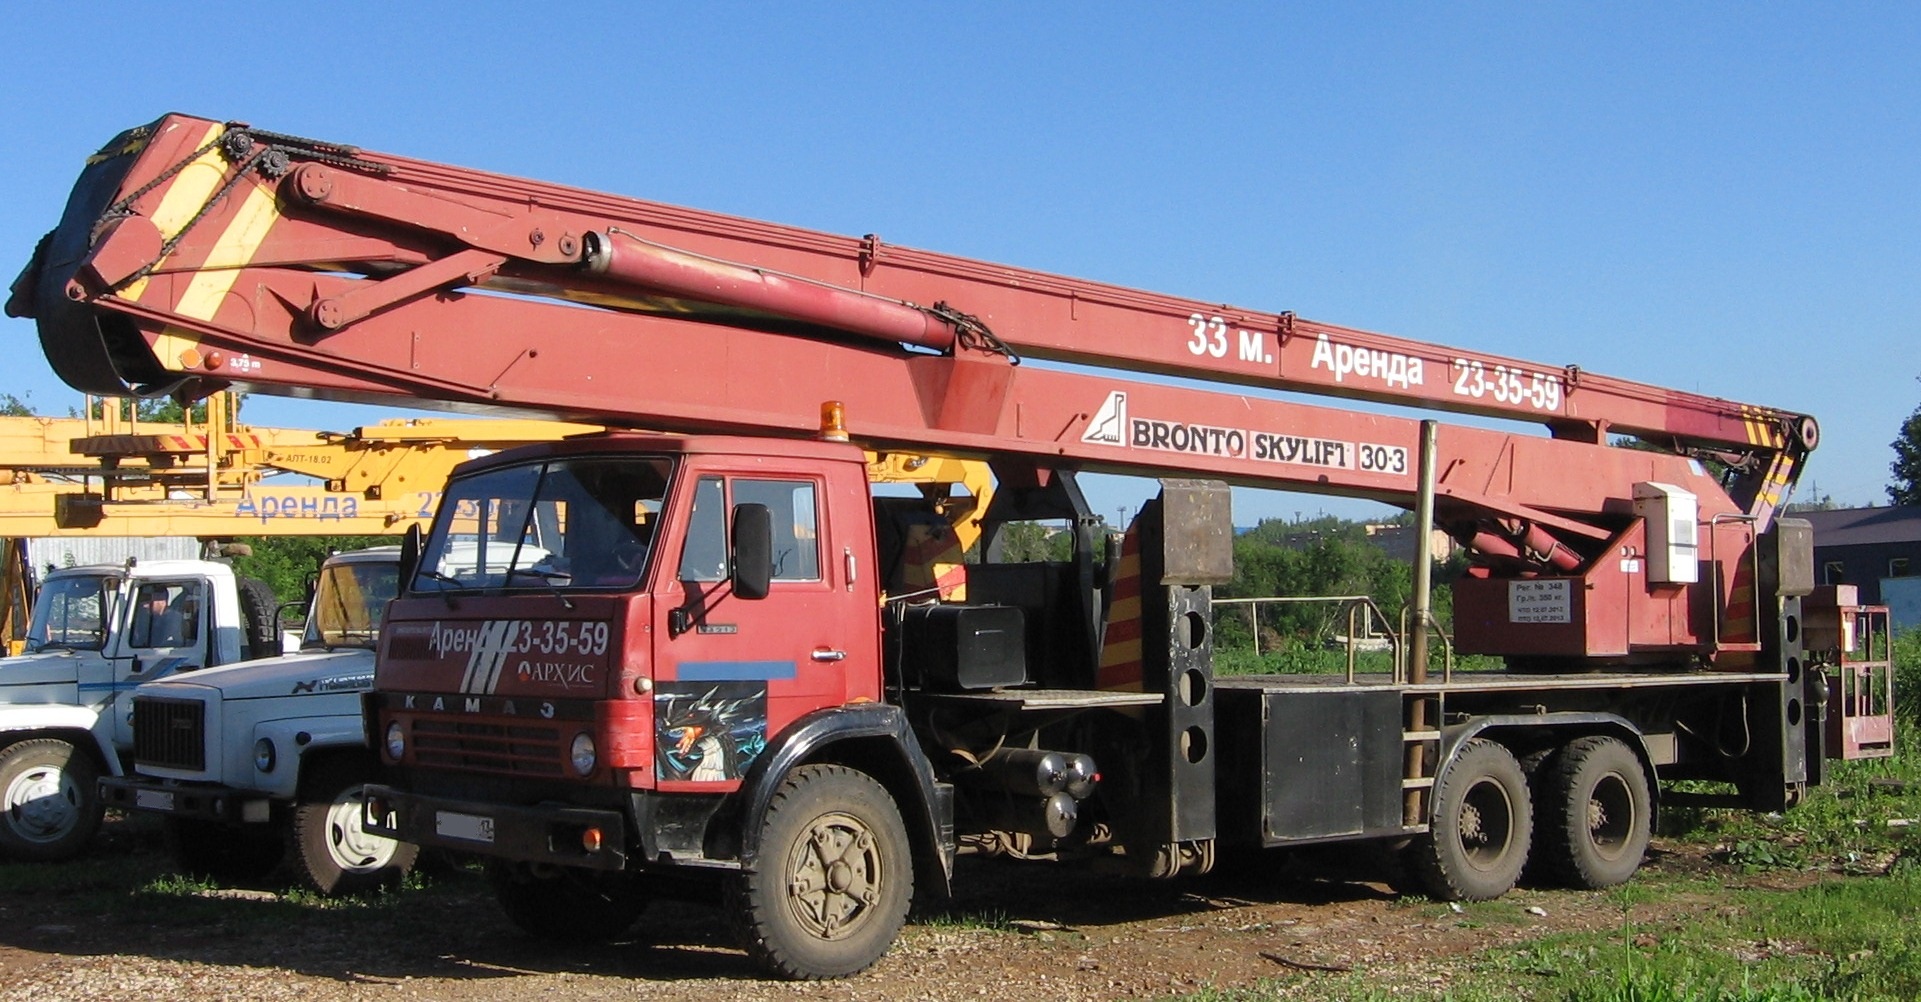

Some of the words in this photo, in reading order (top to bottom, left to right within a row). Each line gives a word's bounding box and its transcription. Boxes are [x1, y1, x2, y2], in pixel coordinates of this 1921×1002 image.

[1188, 313, 1228, 359] 33
[1310, 332, 1424, 390] Аренда
[1453, 357, 1560, 412] 23-35-59
[1132, 419, 1245, 458] BRONTO
[1254, 432, 1347, 468] SKYLIFT
[234, 492, 358, 525] Аренда
[531, 662, 595, 690] АРХИС
